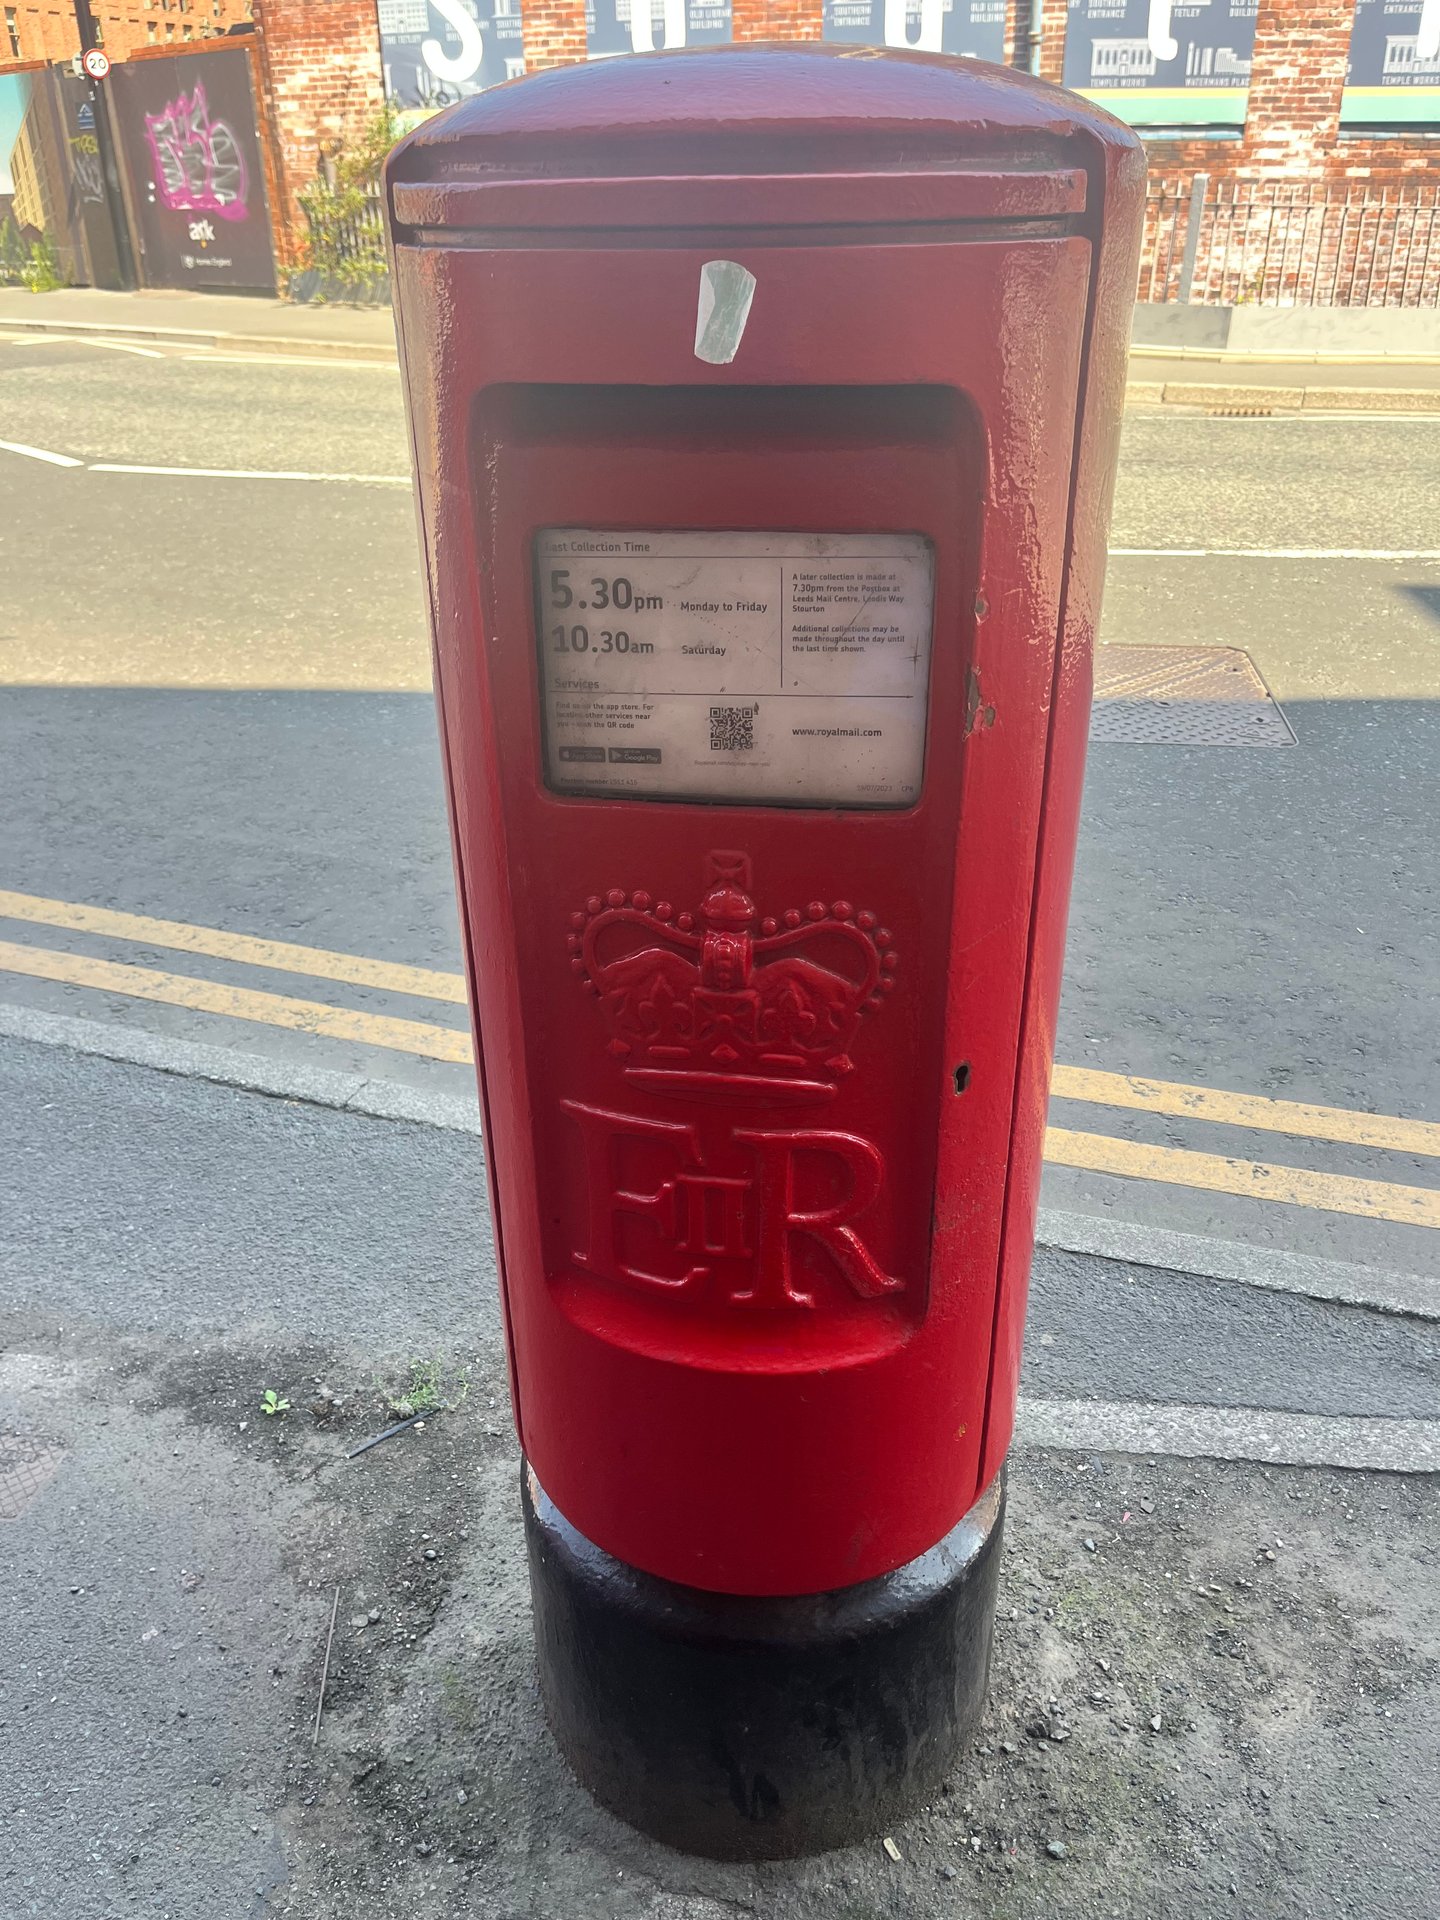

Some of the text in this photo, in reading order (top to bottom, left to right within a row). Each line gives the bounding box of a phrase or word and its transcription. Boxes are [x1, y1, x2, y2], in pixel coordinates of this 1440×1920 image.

[90, 58, 106, 70] 20
[545, 542, 650, 552] Last Collection Time
[551, 570, 663, 613] 5.30pm
[792, 584, 824, 593] 7.30pm
[888, 595, 904, 604] Way
[680, 601, 768, 613] Monday to Friday
[872, 626, 887, 634] may
[551, 625, 654, 654] 10.30am
[814, 635, 855, 643] throughout
[872, 635, 885, 644] day
[682, 645, 727, 656] Saturday
[554, 679, 599, 689] Services
[792, 728, 882, 738] www.royalmail.com
[624, 753, 645, 762] Google
